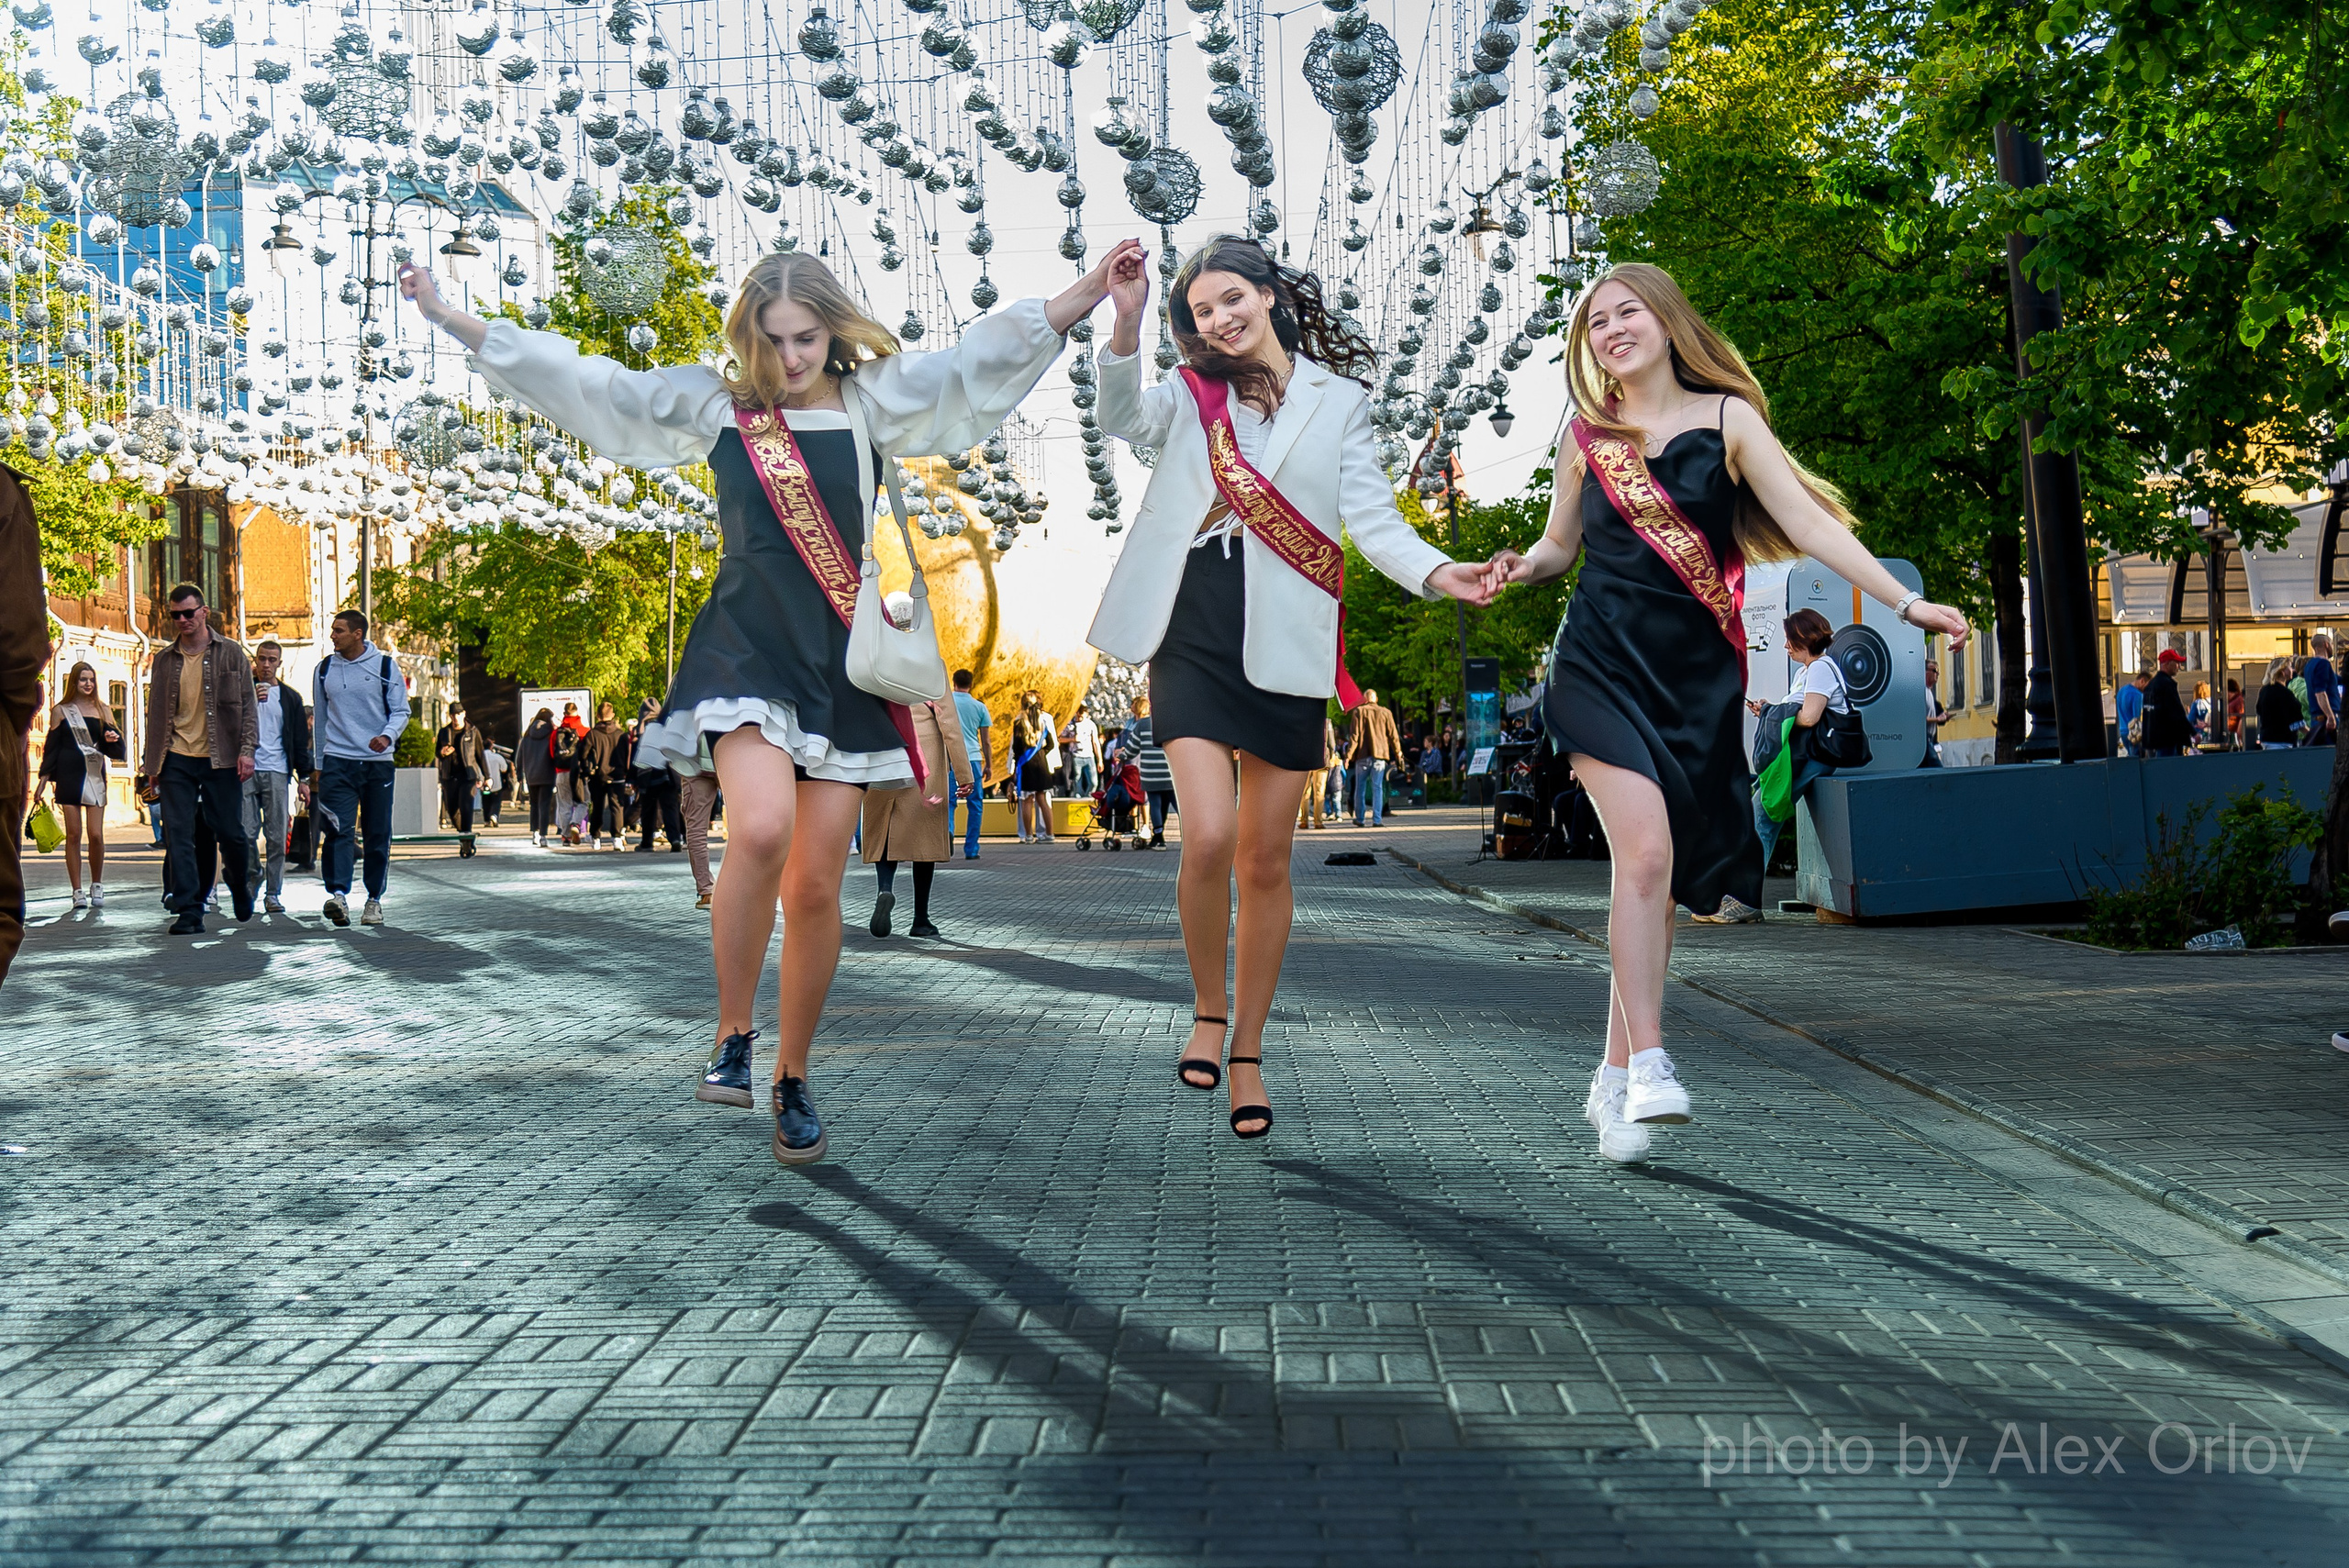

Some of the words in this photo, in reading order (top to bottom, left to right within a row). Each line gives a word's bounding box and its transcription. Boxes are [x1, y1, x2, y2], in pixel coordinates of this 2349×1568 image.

[767, 458, 848, 588] Выпускник
[829, 583, 860, 623] 20
[1218, 462, 1316, 560] Выпускник
[1604, 458, 1708, 577] Выпускник
[1751, 613, 1766, 622] фото
